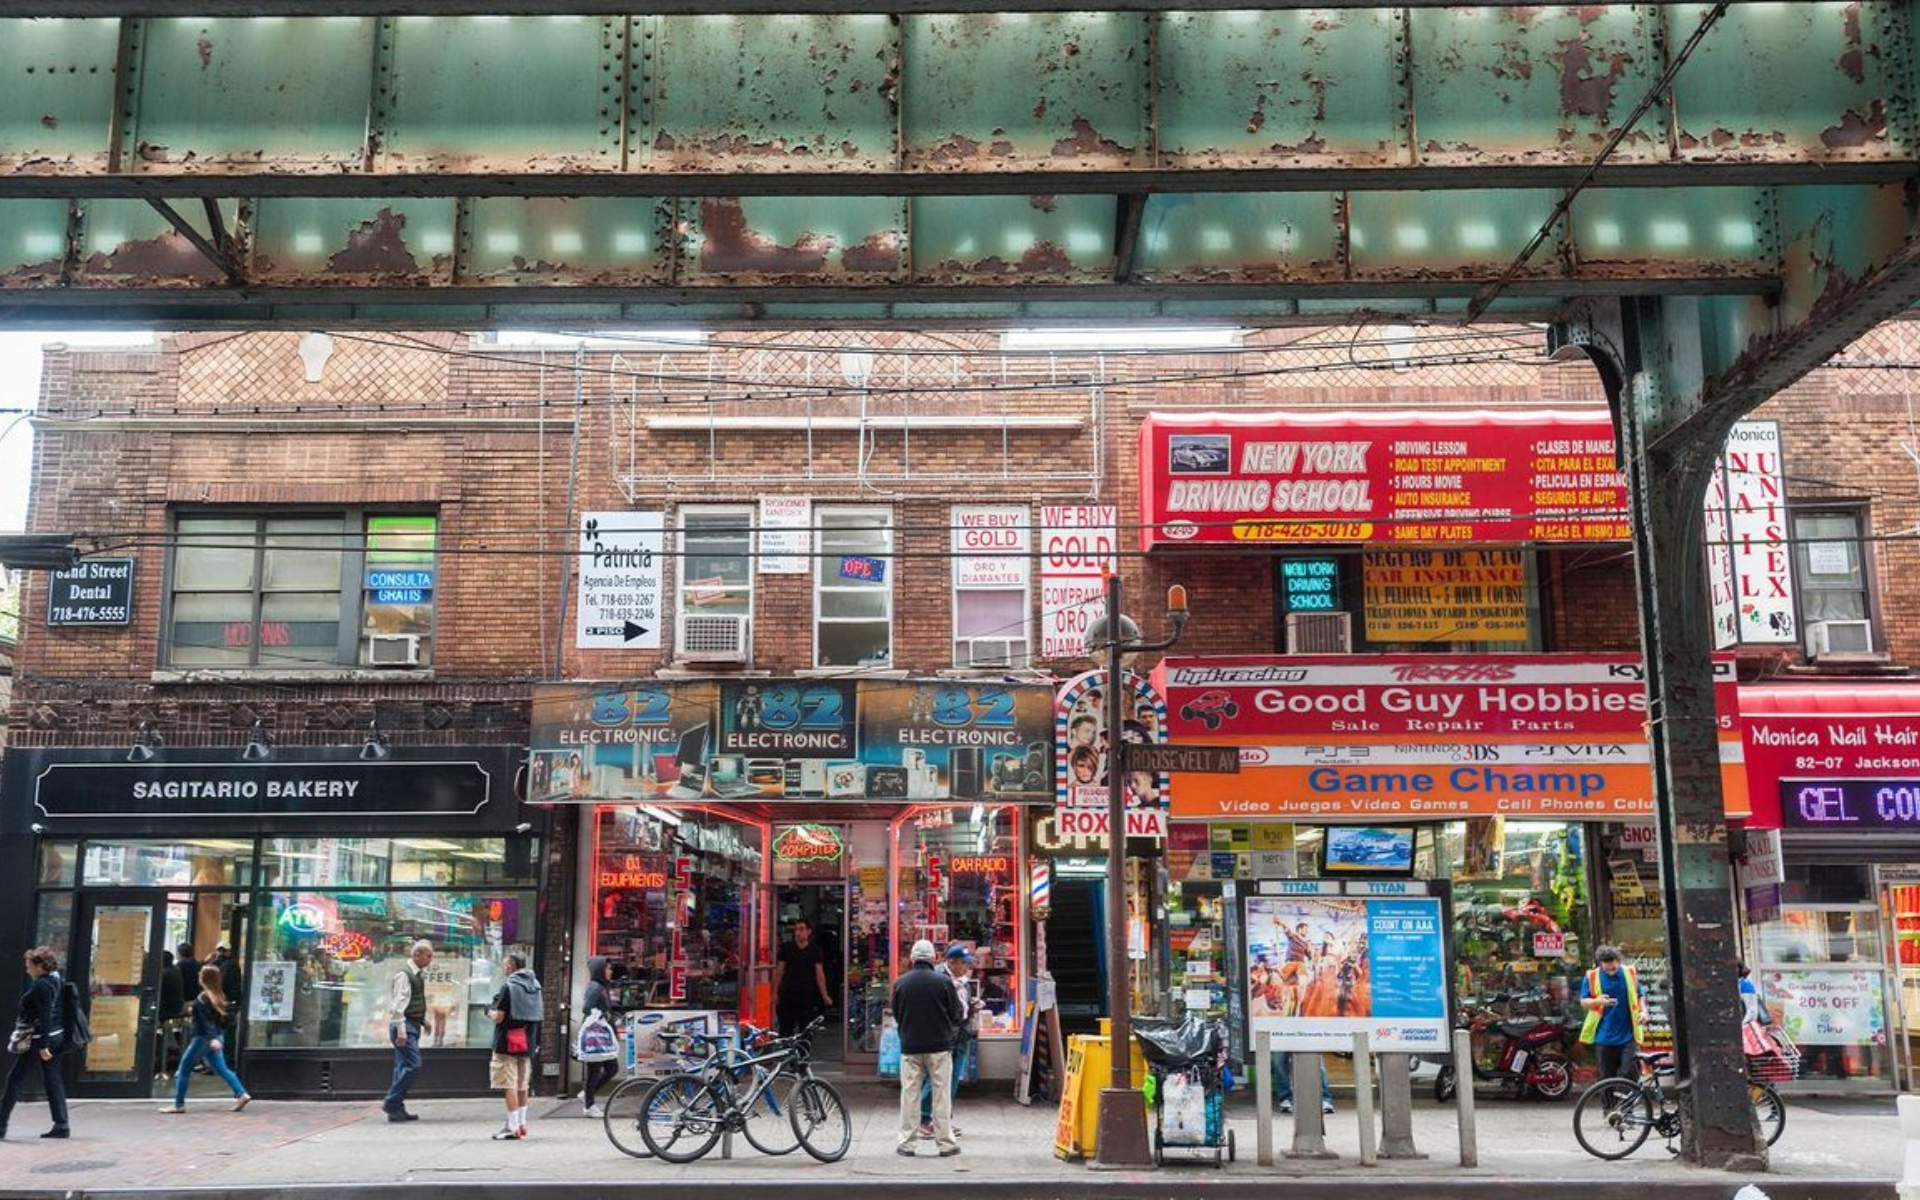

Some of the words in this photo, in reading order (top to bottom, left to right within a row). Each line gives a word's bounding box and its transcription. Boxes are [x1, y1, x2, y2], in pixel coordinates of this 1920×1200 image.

[1395, 442, 1430, 455] DRIVING
[1432, 442, 1467, 455] LESSON
[1537, 440, 1570, 454] CLASES
[1572, 440, 1584, 454] DE
[1586, 440, 1616, 454] MANEJ
[1240, 441, 1300, 474] NEW
[1302, 441, 1372, 474] YORK
[1395, 458, 1419, 472] ROAD
[1421, 458, 1442, 472] TEST
[1444, 458, 1506, 472] APPOINTMENT
[1537, 457, 1556, 471] CITA
[1559, 457, 1581, 471] PARA
[1583, 457, 1594, 471] EL
[1596, 457, 1616, 471] EXA
[1394, 475, 1400, 488] 5
[1402, 475, 1432, 488] HOURS
[1434, 475, 1462, 488] MOVIE
[1535, 474, 1578, 487] PELICULA
[1580, 474, 1592, 487] EN
[1166, 480, 1271, 512] DRIVING
[1272, 480, 1373, 512] SCHOOL
[1395, 492, 1418, 505] AUTO
[1420, 492, 1471, 505] INSURANCE
[1536, 491, 1577, 505] SEGUROS
[1579, 491, 1590, 505] DE
[962, 514, 984, 526] WE
[988, 514, 1018, 526] BUY
[1076, 507, 1113, 529] BUY
[1243, 522, 1361, 538] 718-426-3018
[1395, 526, 1419, 539] SAME
[1421, 526, 1437, 539] DAY
[1440, 525, 1473, 539] PLATES
[965, 530, 1017, 546] GOLD
[593, 541, 652, 568] Patricia
[1049, 536, 1111, 568] GOLD
[90, 563, 128, 579] Street
[1284, 562, 1306, 576] NEW
[1308, 562, 1335, 576] YORK
[1366, 569, 1402, 583] CAR
[1414, 569, 1524, 583] INSURANCE
[370, 573, 431, 588] CONSULTA
[583, 575, 611, 590] Agencia
[614, 575, 626, 588] De
[627, 575, 656, 590] Empleos
[1288, 578, 1331, 592] DRIVING
[70, 585, 112, 600] Dental
[601, 593, 654, 606] 718-639-2267
[1044, 588, 1107, 605] COMPRAMO
[1290, 594, 1335, 609] SCHOOL
[53, 606, 126, 621] 718-476-5555
[599, 607, 655, 620] 718-639-2246
[1056, 610, 1088, 633] ORO
[1045, 638, 1087, 656] DIAMA
[592, 690, 672, 726] 82
[761, 687, 843, 730] 82
[931, 687, 1016, 728] 82
[1255, 689, 1366, 713] Good
[1381, 688, 1464, 718] Guy
[1479, 688, 1647, 711] Hobbies
[1331, 720, 1380, 731] Sale
[1407, 719, 1483, 735] Repair
[1511, 719, 1575, 731] Parts
[560, 729, 671, 744] ELECTRONIC
[727, 733, 841, 748] ELECTRONIC
[899, 729, 1016, 745] ELECTRONIC
[1752, 725, 1819, 746] Monica
[1828, 725, 1867, 746] Nail
[1875, 724, 1919, 745] Hair
[1304, 747, 1370, 757] PS3
[1463, 744, 1500, 761] 3DS
[1564, 745, 1627, 756] VITA
[1132, 751, 1212, 771] ROOSEVELT
[1219, 751, 1237, 770] AV
[1796, 756, 1843, 769] 82-07
[1855, 756, 1920, 769] Jackson
[133, 781, 258, 798] SAGITARIO
[266, 781, 359, 798] BAKERY
[1309, 768, 1433, 792] Game
[1450, 767, 1606, 798] Champ
[1220, 801, 1270, 812] Video
[1279, 800, 1341, 813] Juegos
[1351, 800, 1401, 811] Video
[1410, 799, 1469, 810] Games
[1497, 798, 1532, 810] Cell
[1540, 798, 1606, 810] Phones
[1613, 798, 1655, 810] Celu
[1799, 787, 1859, 821] GEL
[1061, 812, 1160, 834] ROXNA
[952, 858, 972, 872] CAR
[975, 858, 1006, 872] RADIO
[1281, 881, 1320, 893] TITAN
[1367, 881, 1406, 893] TITAN
[279, 908, 324, 928] ATM
[671, 856, 691, 999] SALE
[1799, 996, 1828, 1009] 20%
[1832, 996, 1860, 1009] OFF
